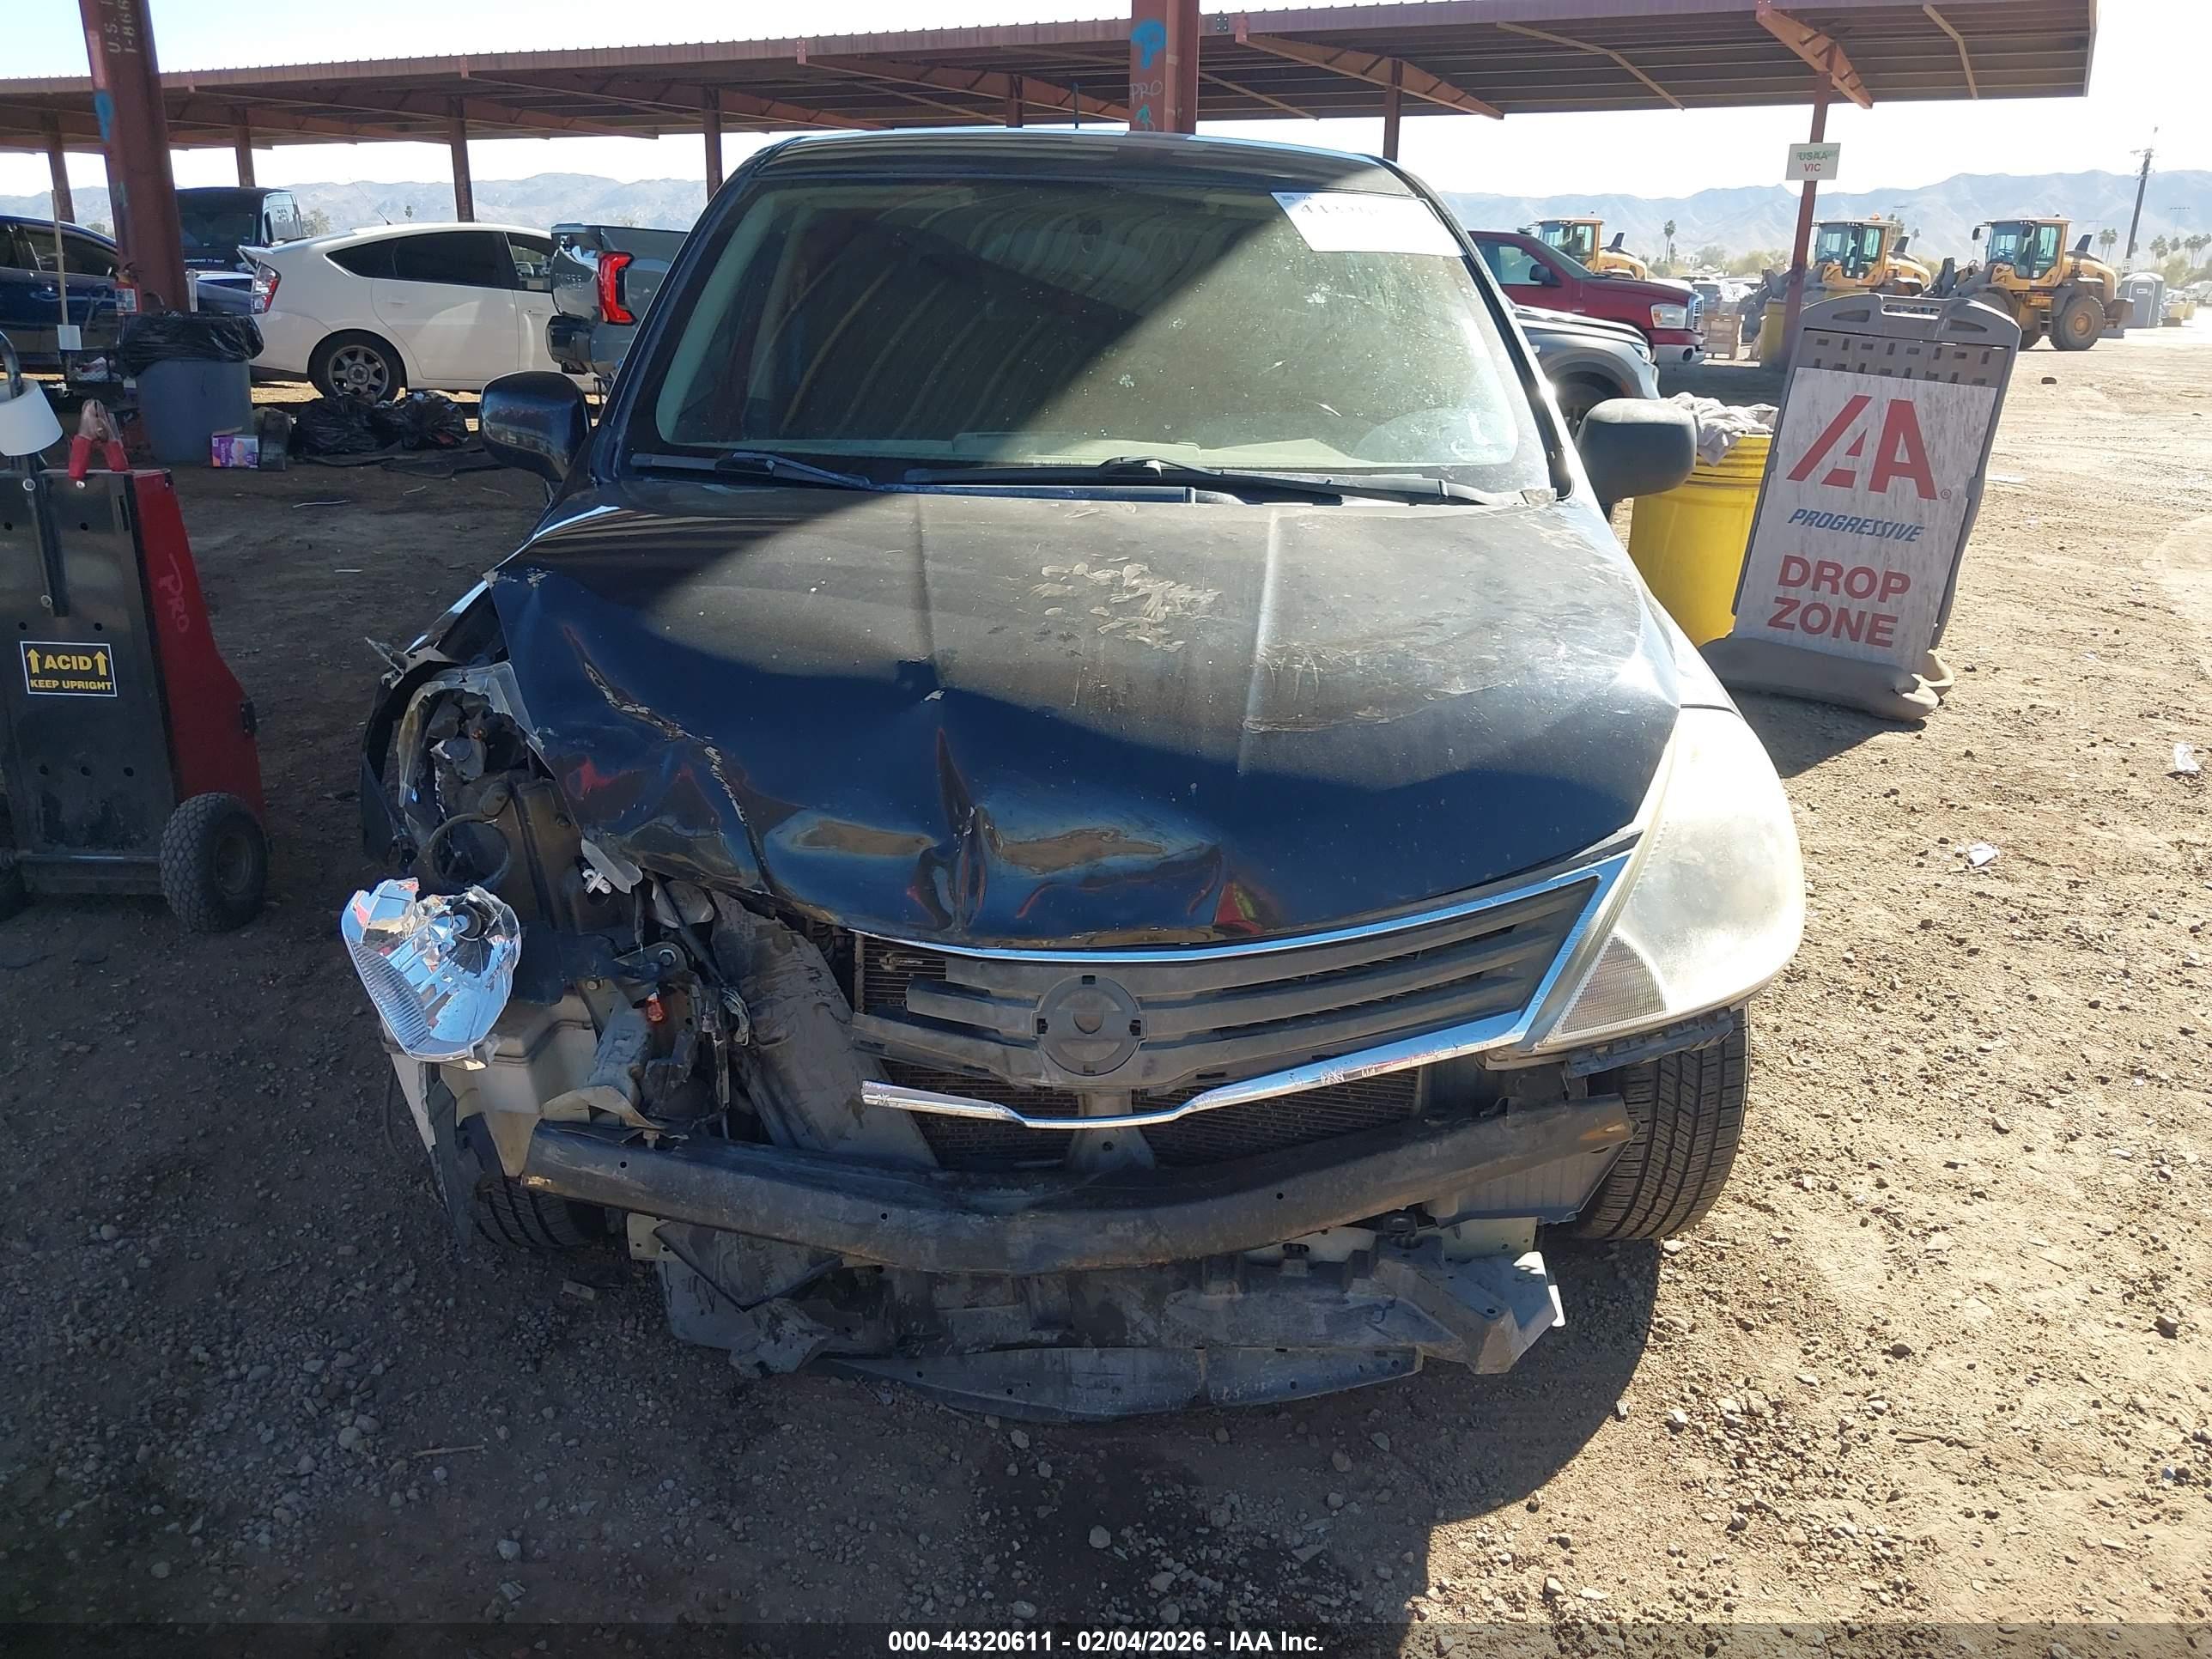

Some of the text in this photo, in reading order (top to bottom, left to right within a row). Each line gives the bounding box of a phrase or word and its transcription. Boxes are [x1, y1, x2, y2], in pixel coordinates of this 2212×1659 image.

[1803, 162, 1821, 173] VIC
[1787, 508, 1925, 543] PROGRESSIVE
[1778, 555, 1911, 604] DROP
[1767, 596, 1899, 648] ZONE
[44, 654, 94, 671] ACID
[29, 678, 112, 690] KEEP UPRIGHT
